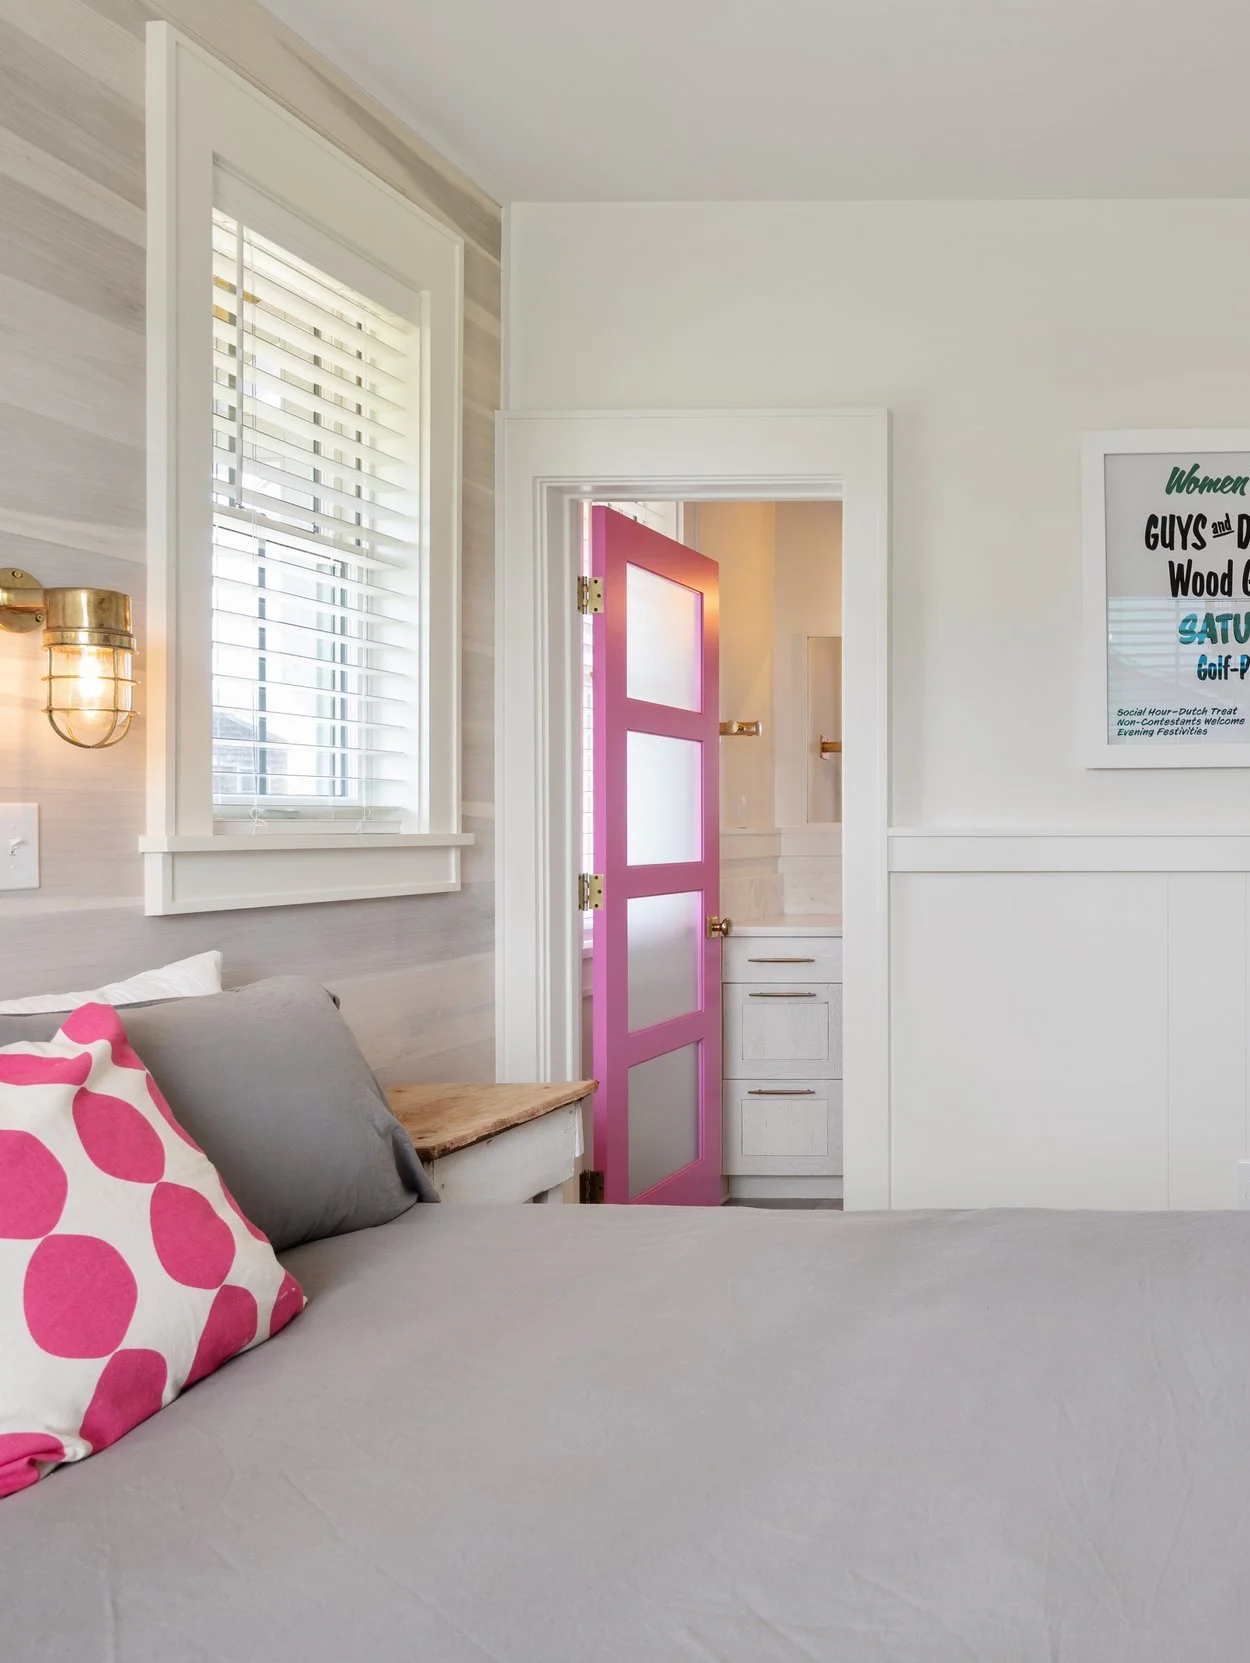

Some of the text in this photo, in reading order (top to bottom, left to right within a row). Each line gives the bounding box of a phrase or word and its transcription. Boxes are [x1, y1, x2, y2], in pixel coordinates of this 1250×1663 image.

[1145, 513, 1208, 552] GUYS
[1211, 513, 1235, 539] and
[1168, 559, 1234, 598] Wood
[1116, 707, 1147, 716] Social
[1210, 706, 1238, 716] Treat
[1116, 716, 1246, 727] Non-Contestants Welcome
[1116, 726, 1208, 738] Evening Festivities
